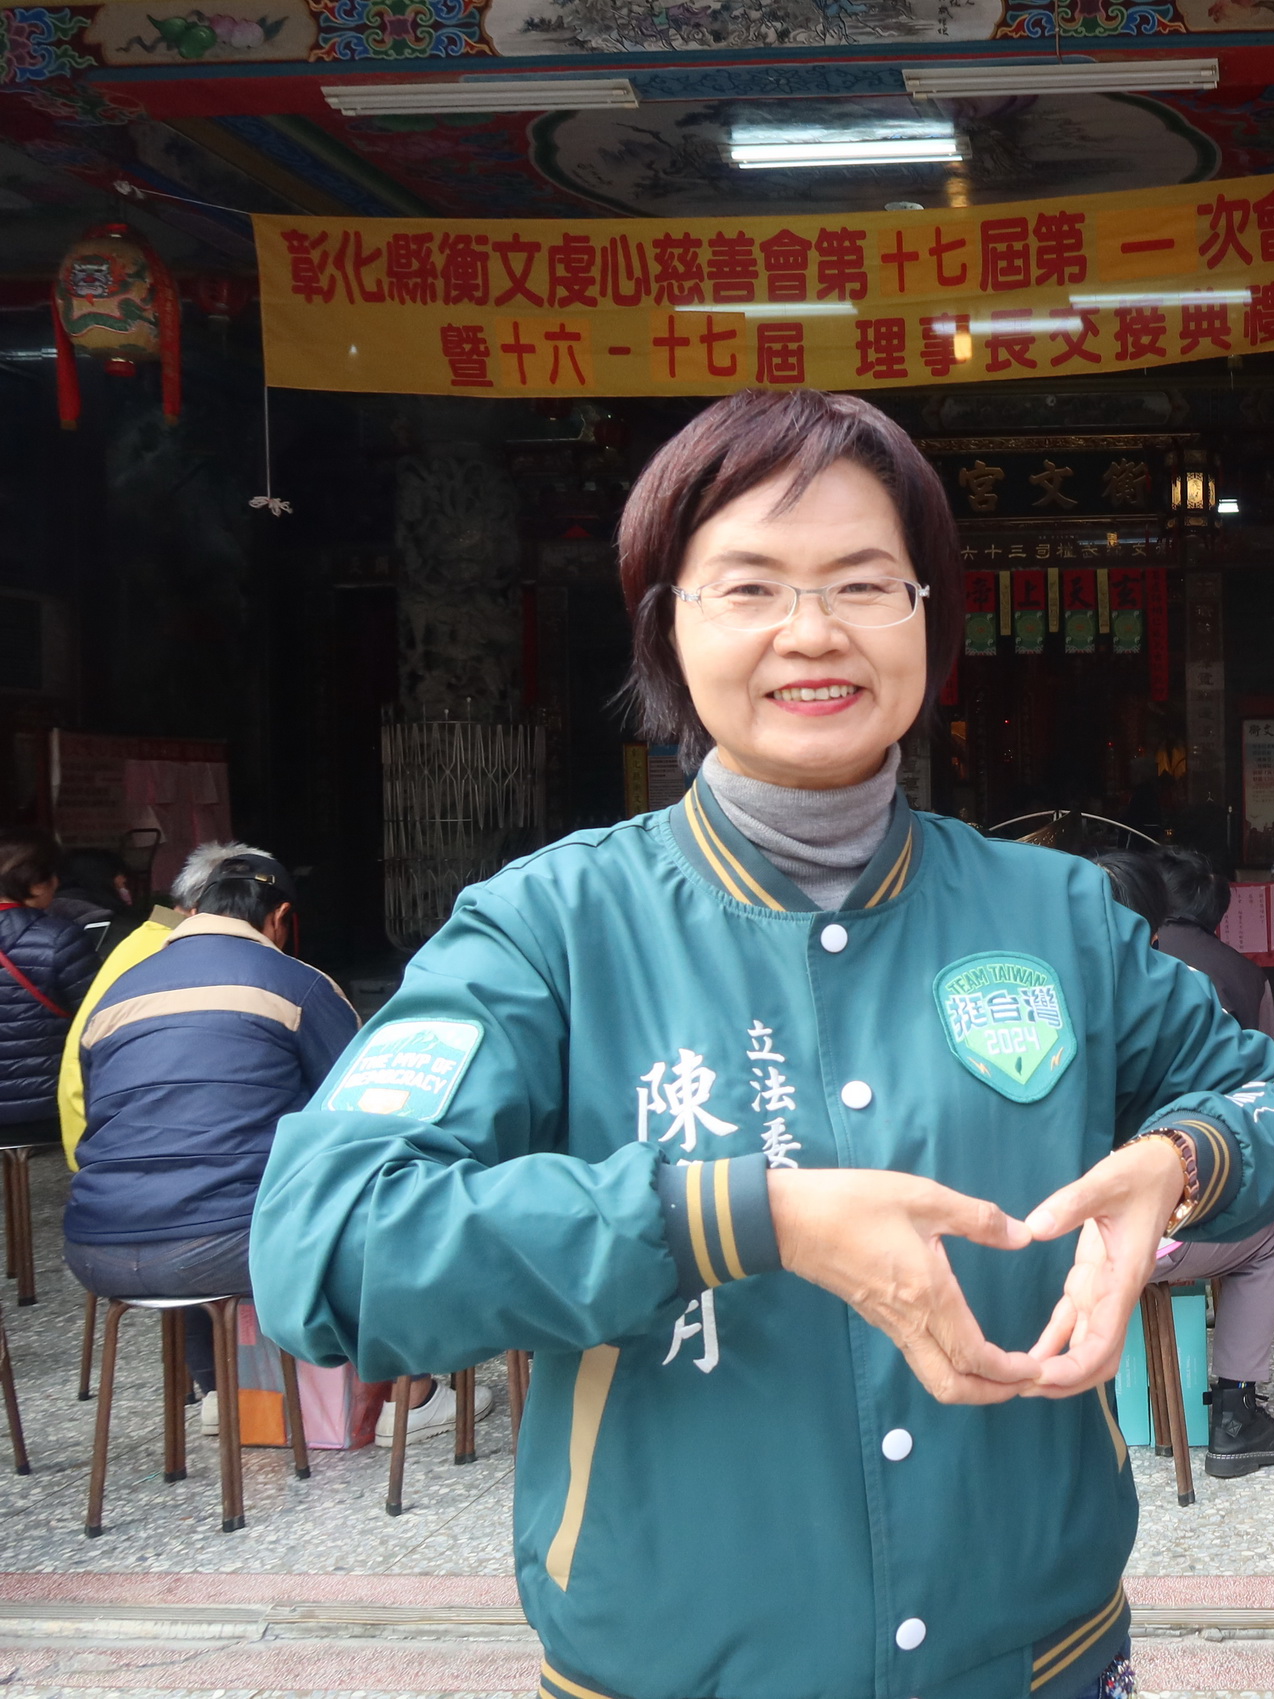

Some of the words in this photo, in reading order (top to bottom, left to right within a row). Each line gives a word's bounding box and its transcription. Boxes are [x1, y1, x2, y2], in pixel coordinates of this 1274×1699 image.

[945, 966, 991, 996] TEAM
[986, 963, 1048, 989] TAIWAN
[985, 1025, 1042, 1055] 2024
[357, 1053, 394, 1071] THE
[391, 1051, 432, 1068] MVP
[430, 1057, 457, 1075] OF
